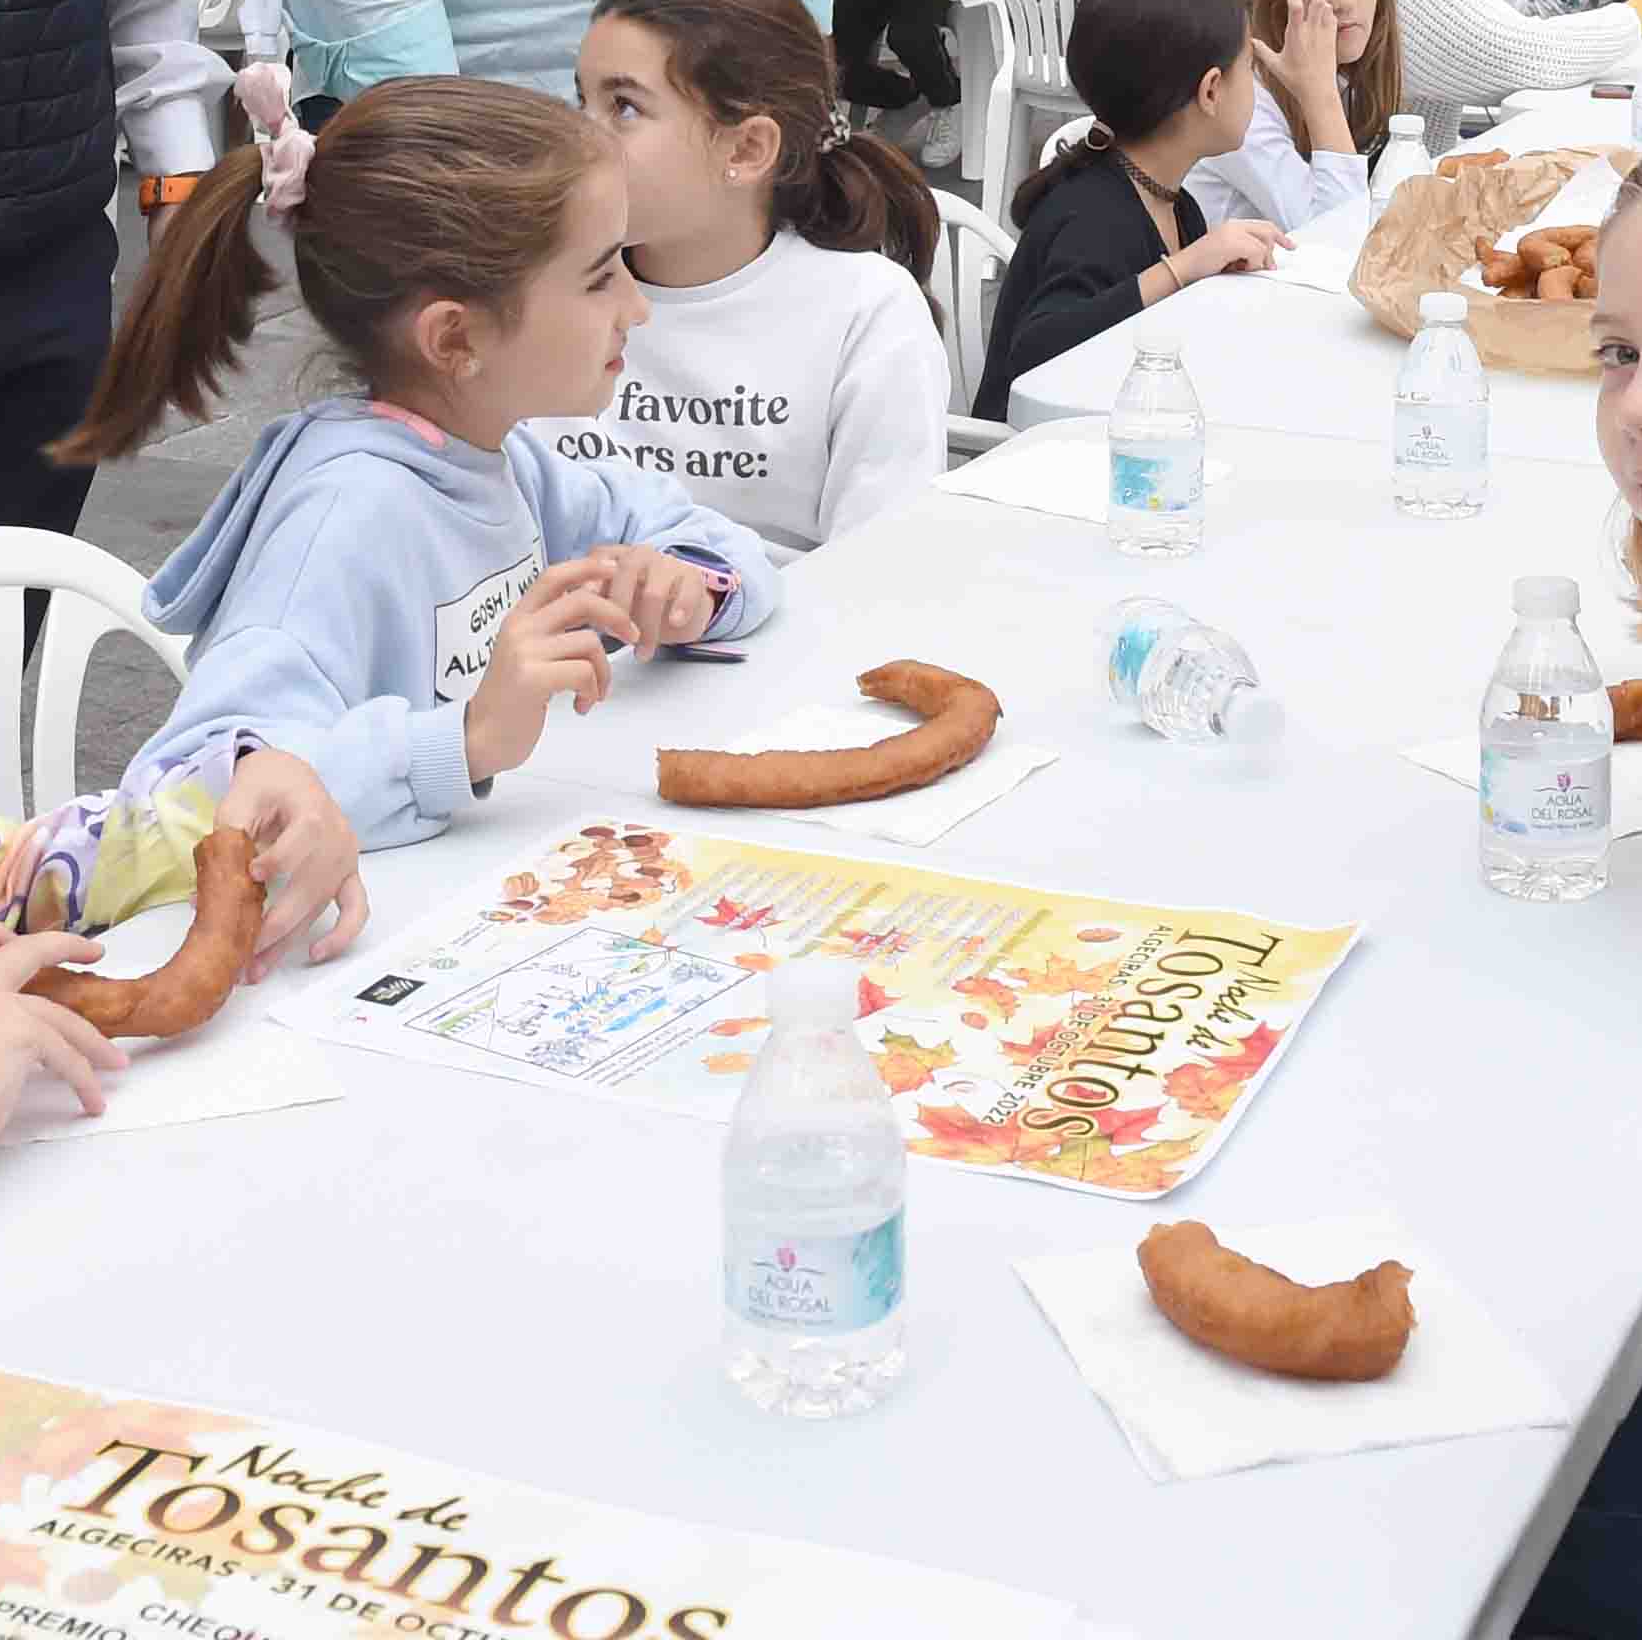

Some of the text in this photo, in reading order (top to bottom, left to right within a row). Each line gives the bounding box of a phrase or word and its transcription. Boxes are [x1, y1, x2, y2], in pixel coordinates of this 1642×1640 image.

[618, 381, 790, 427] favorite
[685, 448, 769, 479] are:
[470, 579, 511, 634] GOSH!
[445, 653, 487, 679] ALL
[1531, 807, 1553, 820] DEL
[1546, 794, 1582, 807] AGUA
[1108, 924, 1174, 986] ALGECIRAS
[1019, 928, 1284, 1137] Tosantos
[1070, 1010, 1095, 1032] DE
[1186, 970, 1281, 1049] Noche de
[1012, 1028, 1083, 1091] OCTUBRE
[981, 1091, 1026, 1126] 2022
[212, 1442, 471, 1532] Noche de
[61, 1438, 735, 1640] Tosantos
[29, 1518, 243, 1579] ALGECIRAS
[270, 1575, 317, 1602] 31
[326, 1591, 388, 1623] DE
